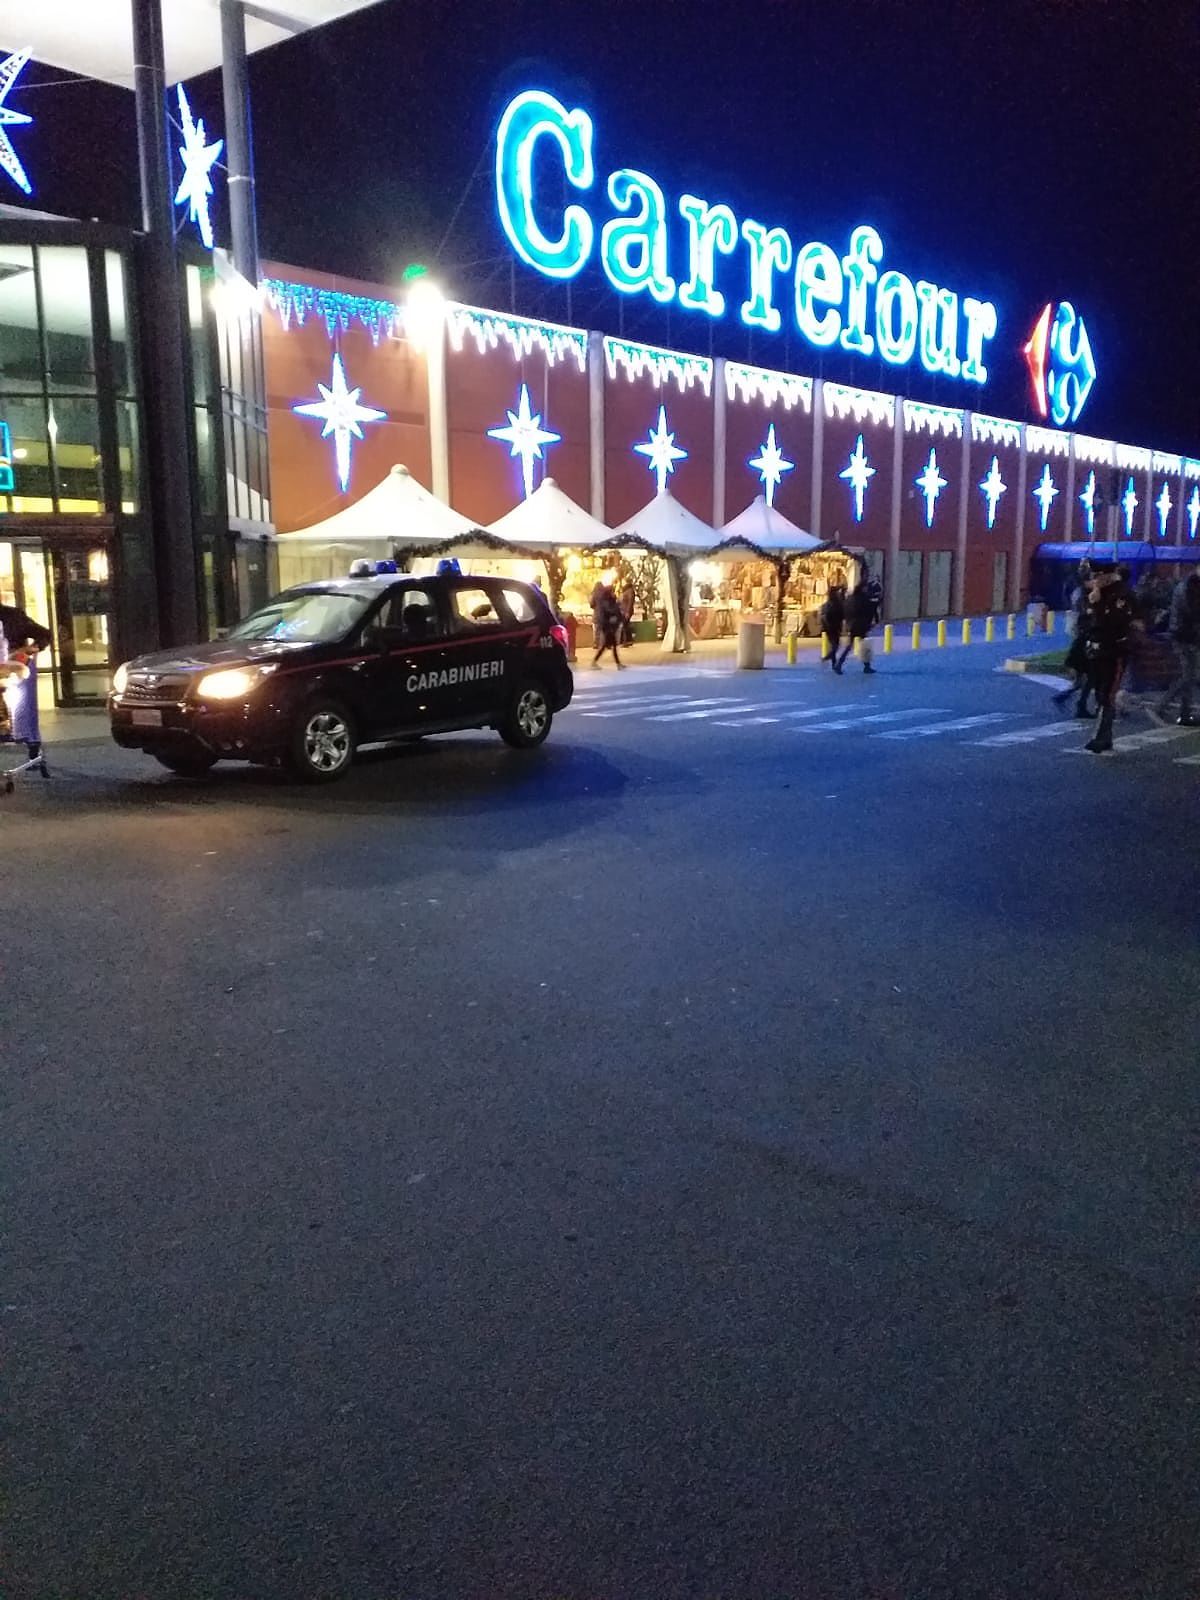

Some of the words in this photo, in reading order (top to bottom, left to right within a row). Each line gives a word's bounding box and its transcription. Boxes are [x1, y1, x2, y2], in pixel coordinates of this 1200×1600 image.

[496, 90, 998, 384] Carrefour
[540, 635, 553, 649] 112
[406, 659, 505, 693] CARABINIERI
